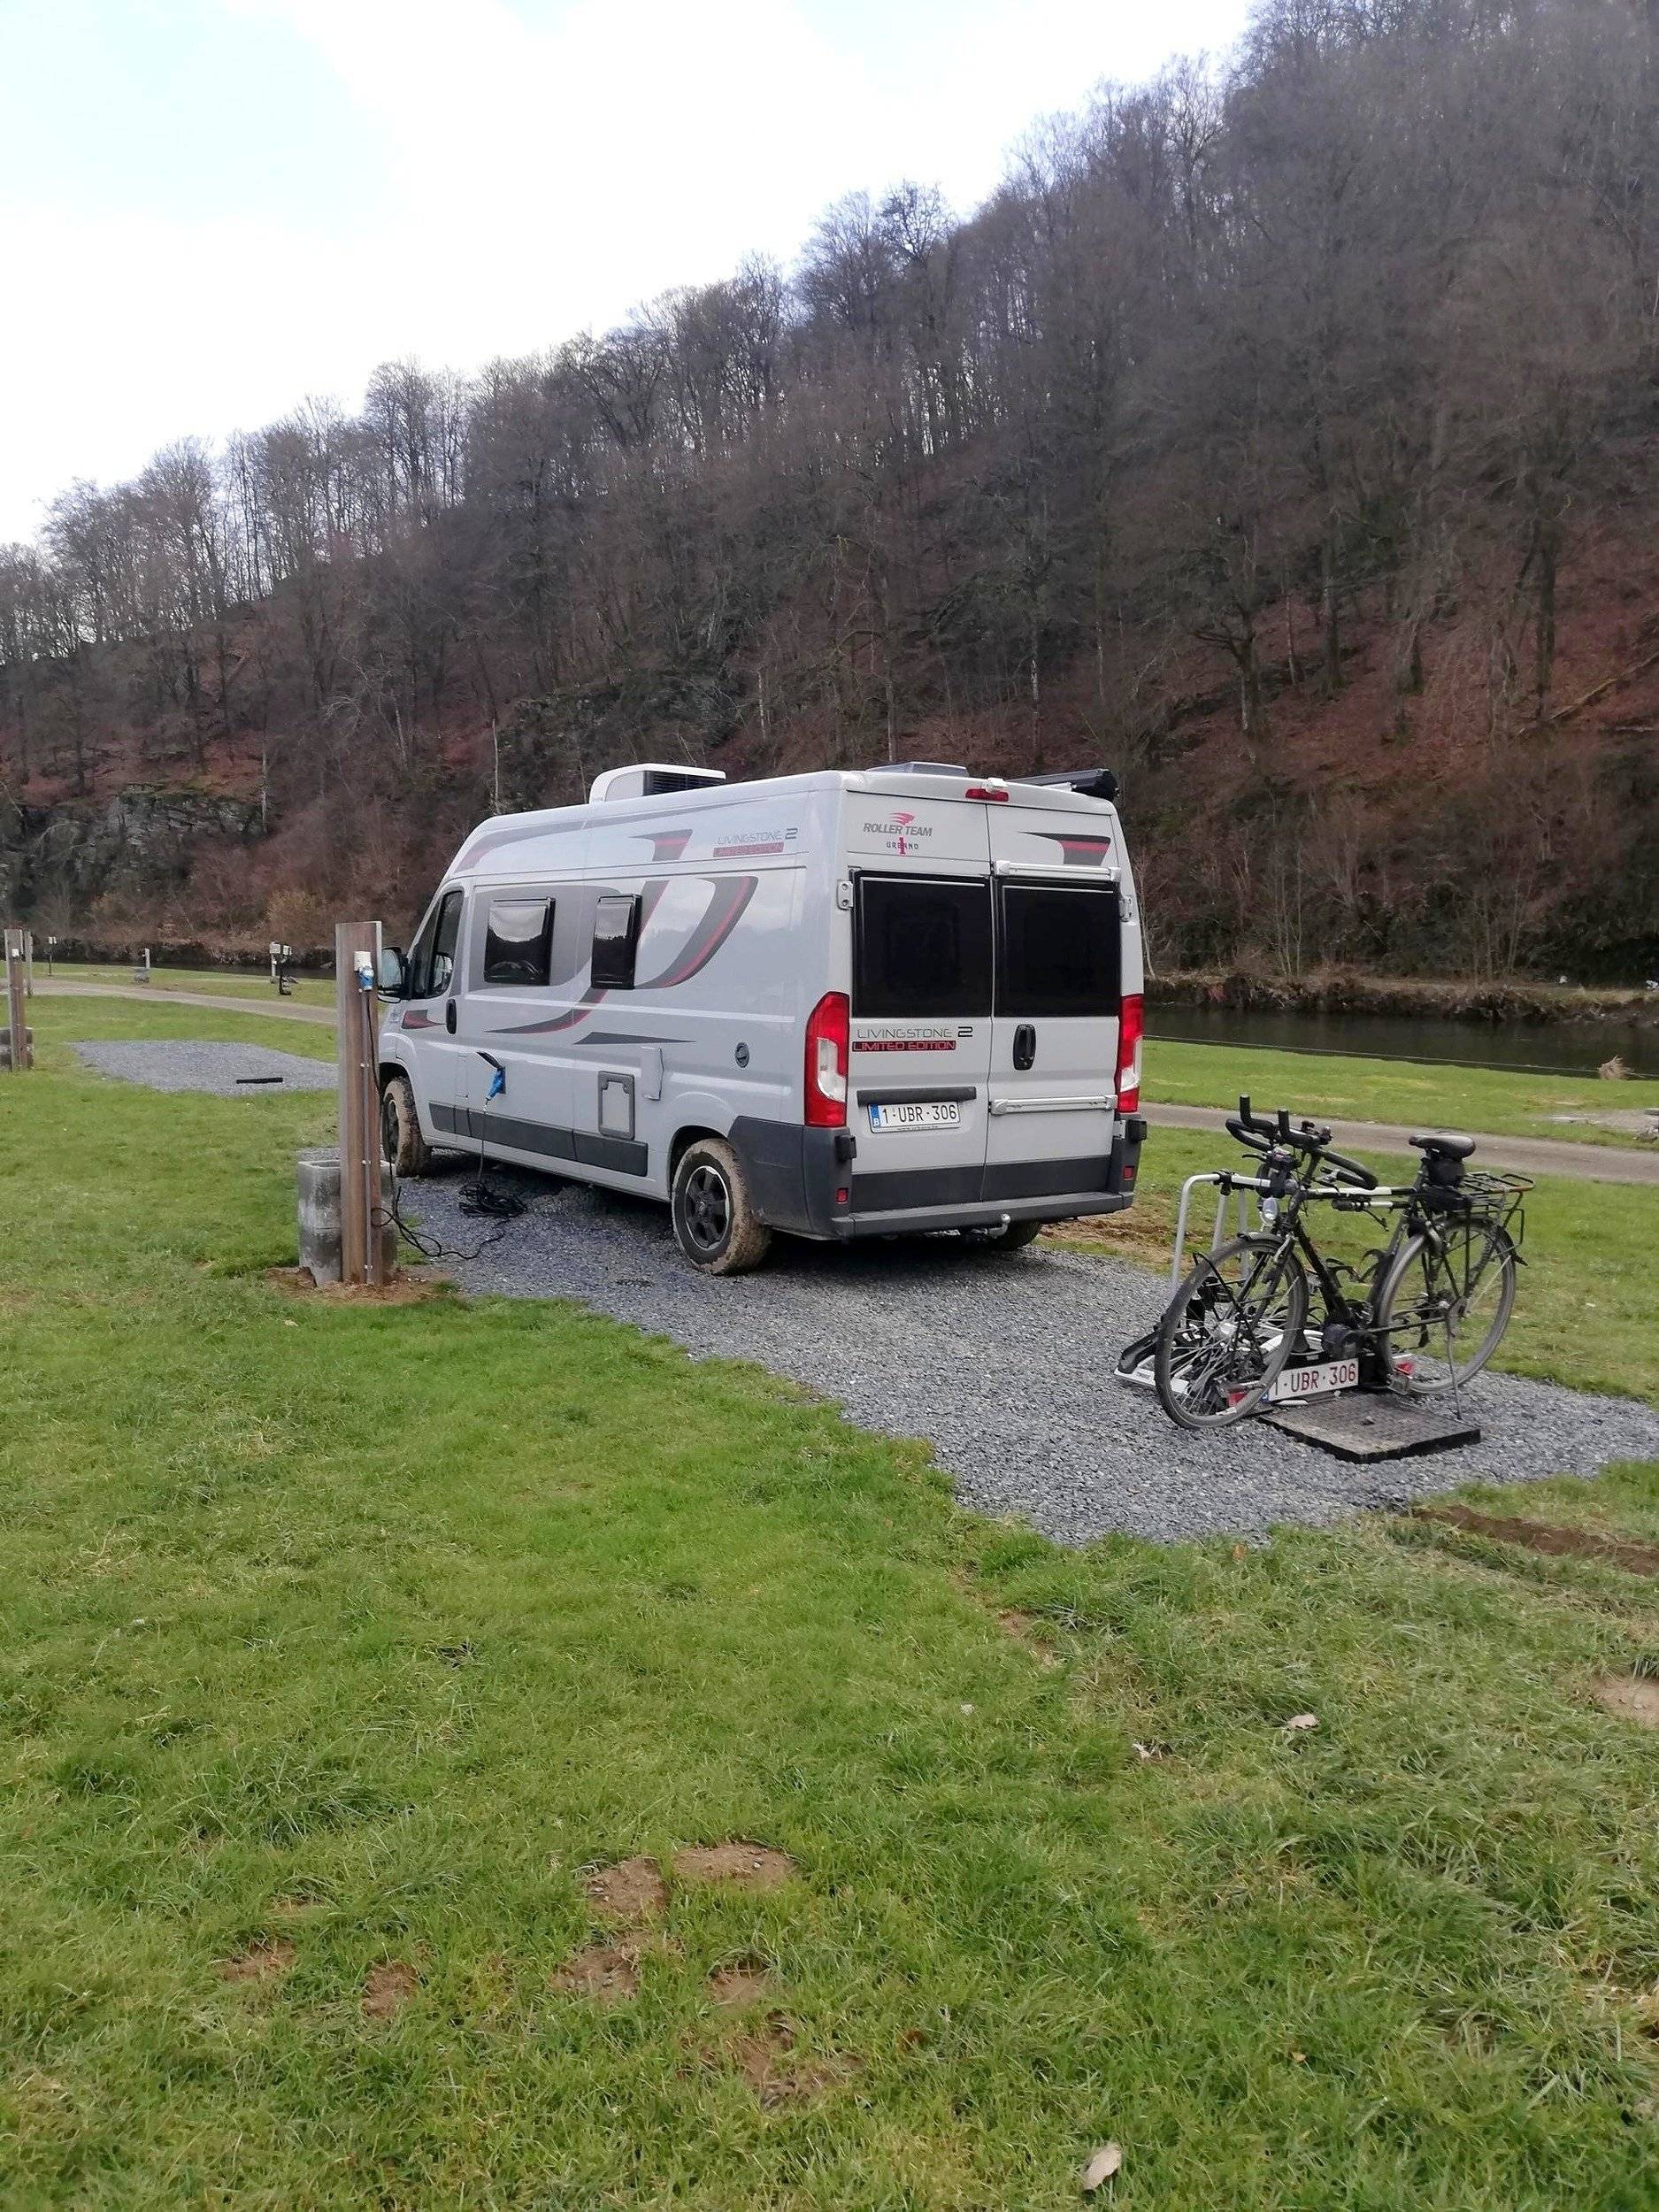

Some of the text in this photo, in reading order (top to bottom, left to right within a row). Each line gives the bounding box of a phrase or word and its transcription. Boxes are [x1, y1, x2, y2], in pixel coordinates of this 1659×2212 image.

[785, 827, 798, 840] 2
[863, 823, 933, 837] ROLLER TEAM
[856, 1026, 973, 1039] LIVINGSTONE 2
[852, 1041, 956, 1051] LIMITED EDITION
[872, 1118, 880, 1127] B
